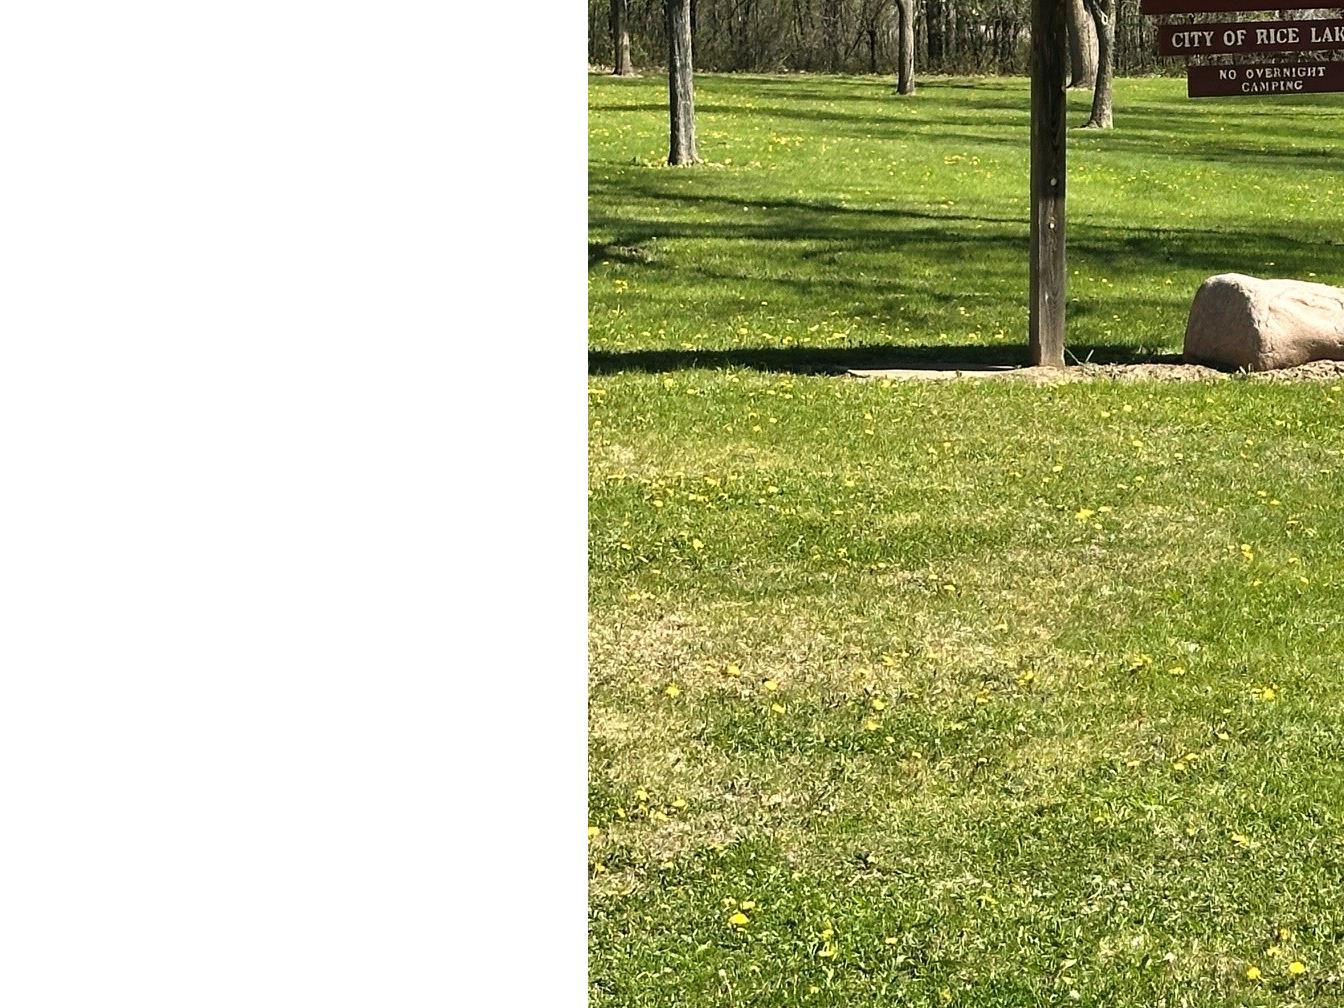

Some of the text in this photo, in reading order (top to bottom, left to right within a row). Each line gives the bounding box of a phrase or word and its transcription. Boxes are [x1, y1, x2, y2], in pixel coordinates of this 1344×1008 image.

[1171, 30, 1214, 48] CITY
[1223, 30, 1247, 46] OF
[1256, 28, 1299, 45] RICE
[1219, 66, 1326, 80] NO OVERNIGHT
[1241, 80, 1304, 92] CAMPING
